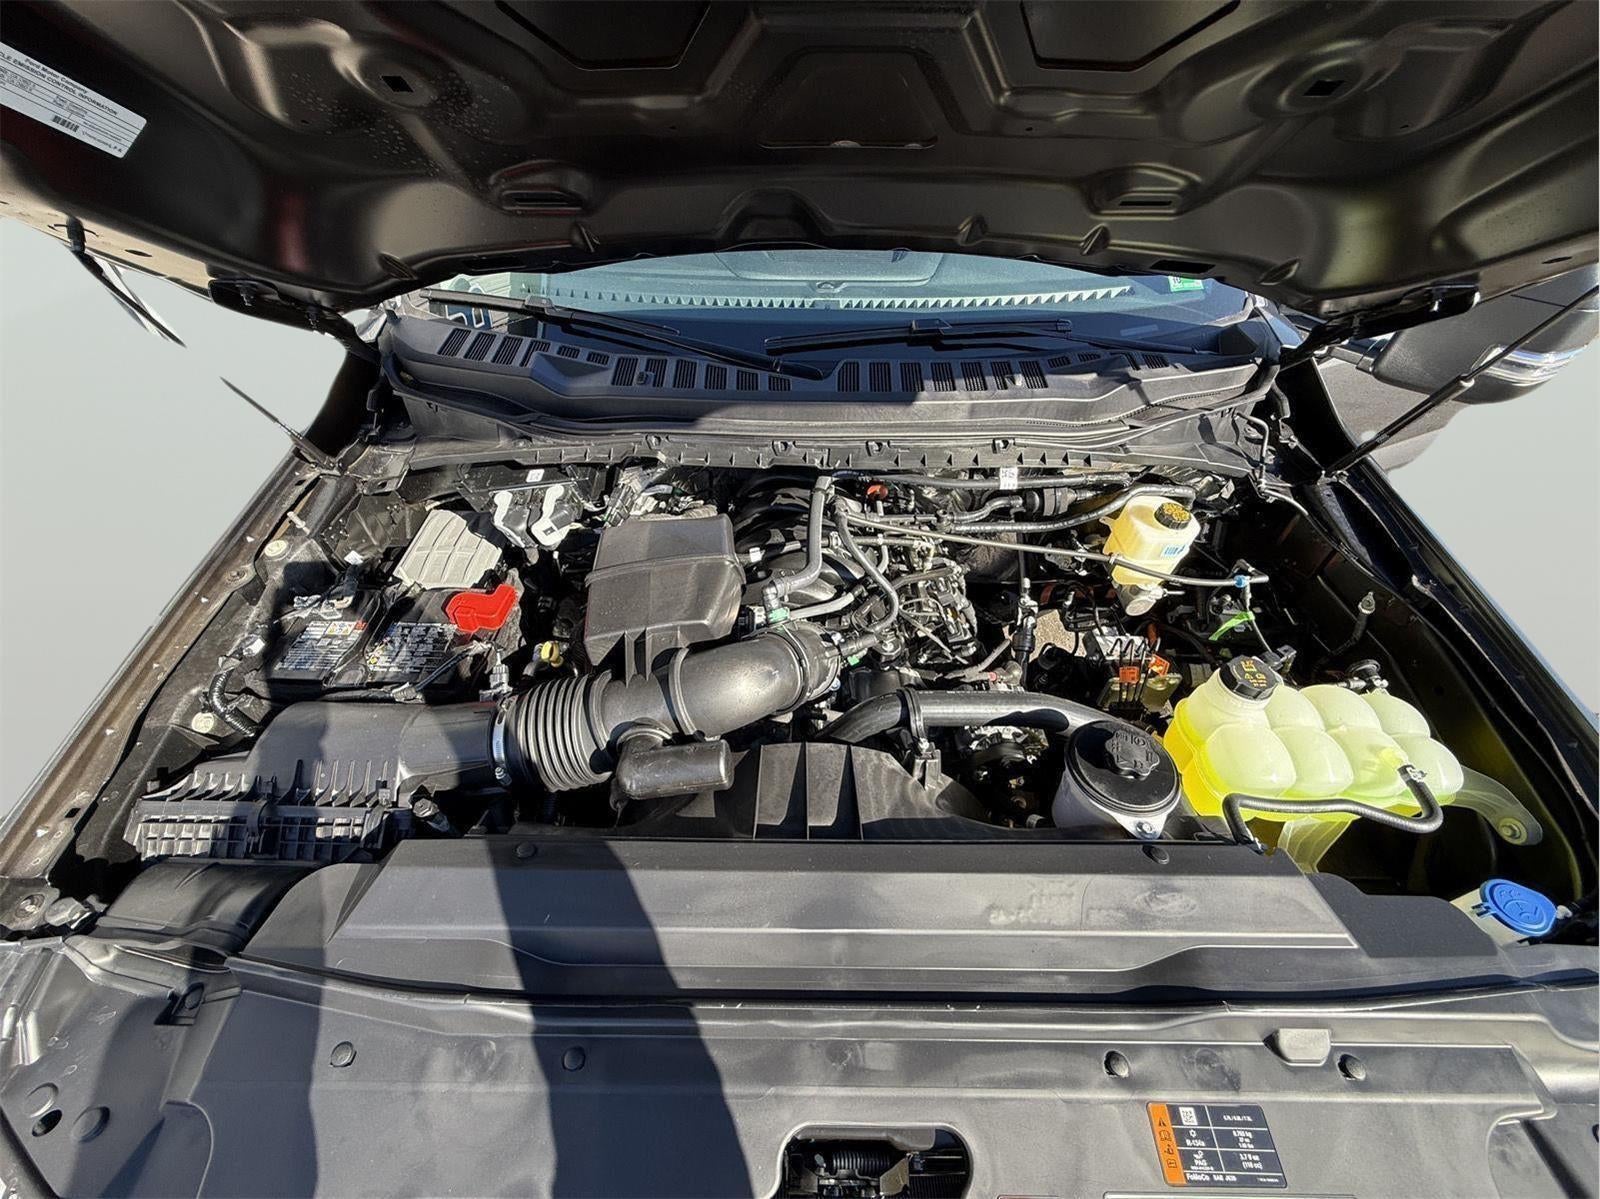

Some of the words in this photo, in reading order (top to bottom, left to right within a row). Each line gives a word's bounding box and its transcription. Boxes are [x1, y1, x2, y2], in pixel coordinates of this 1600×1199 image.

[13, 58, 46, 79] EMISSION
[46, 75, 77, 94] CONTROL
[77, 92, 118, 115] INFORMATION
[41, 66, 60, 78] Motor
[60, 74, 88, 94] Company
